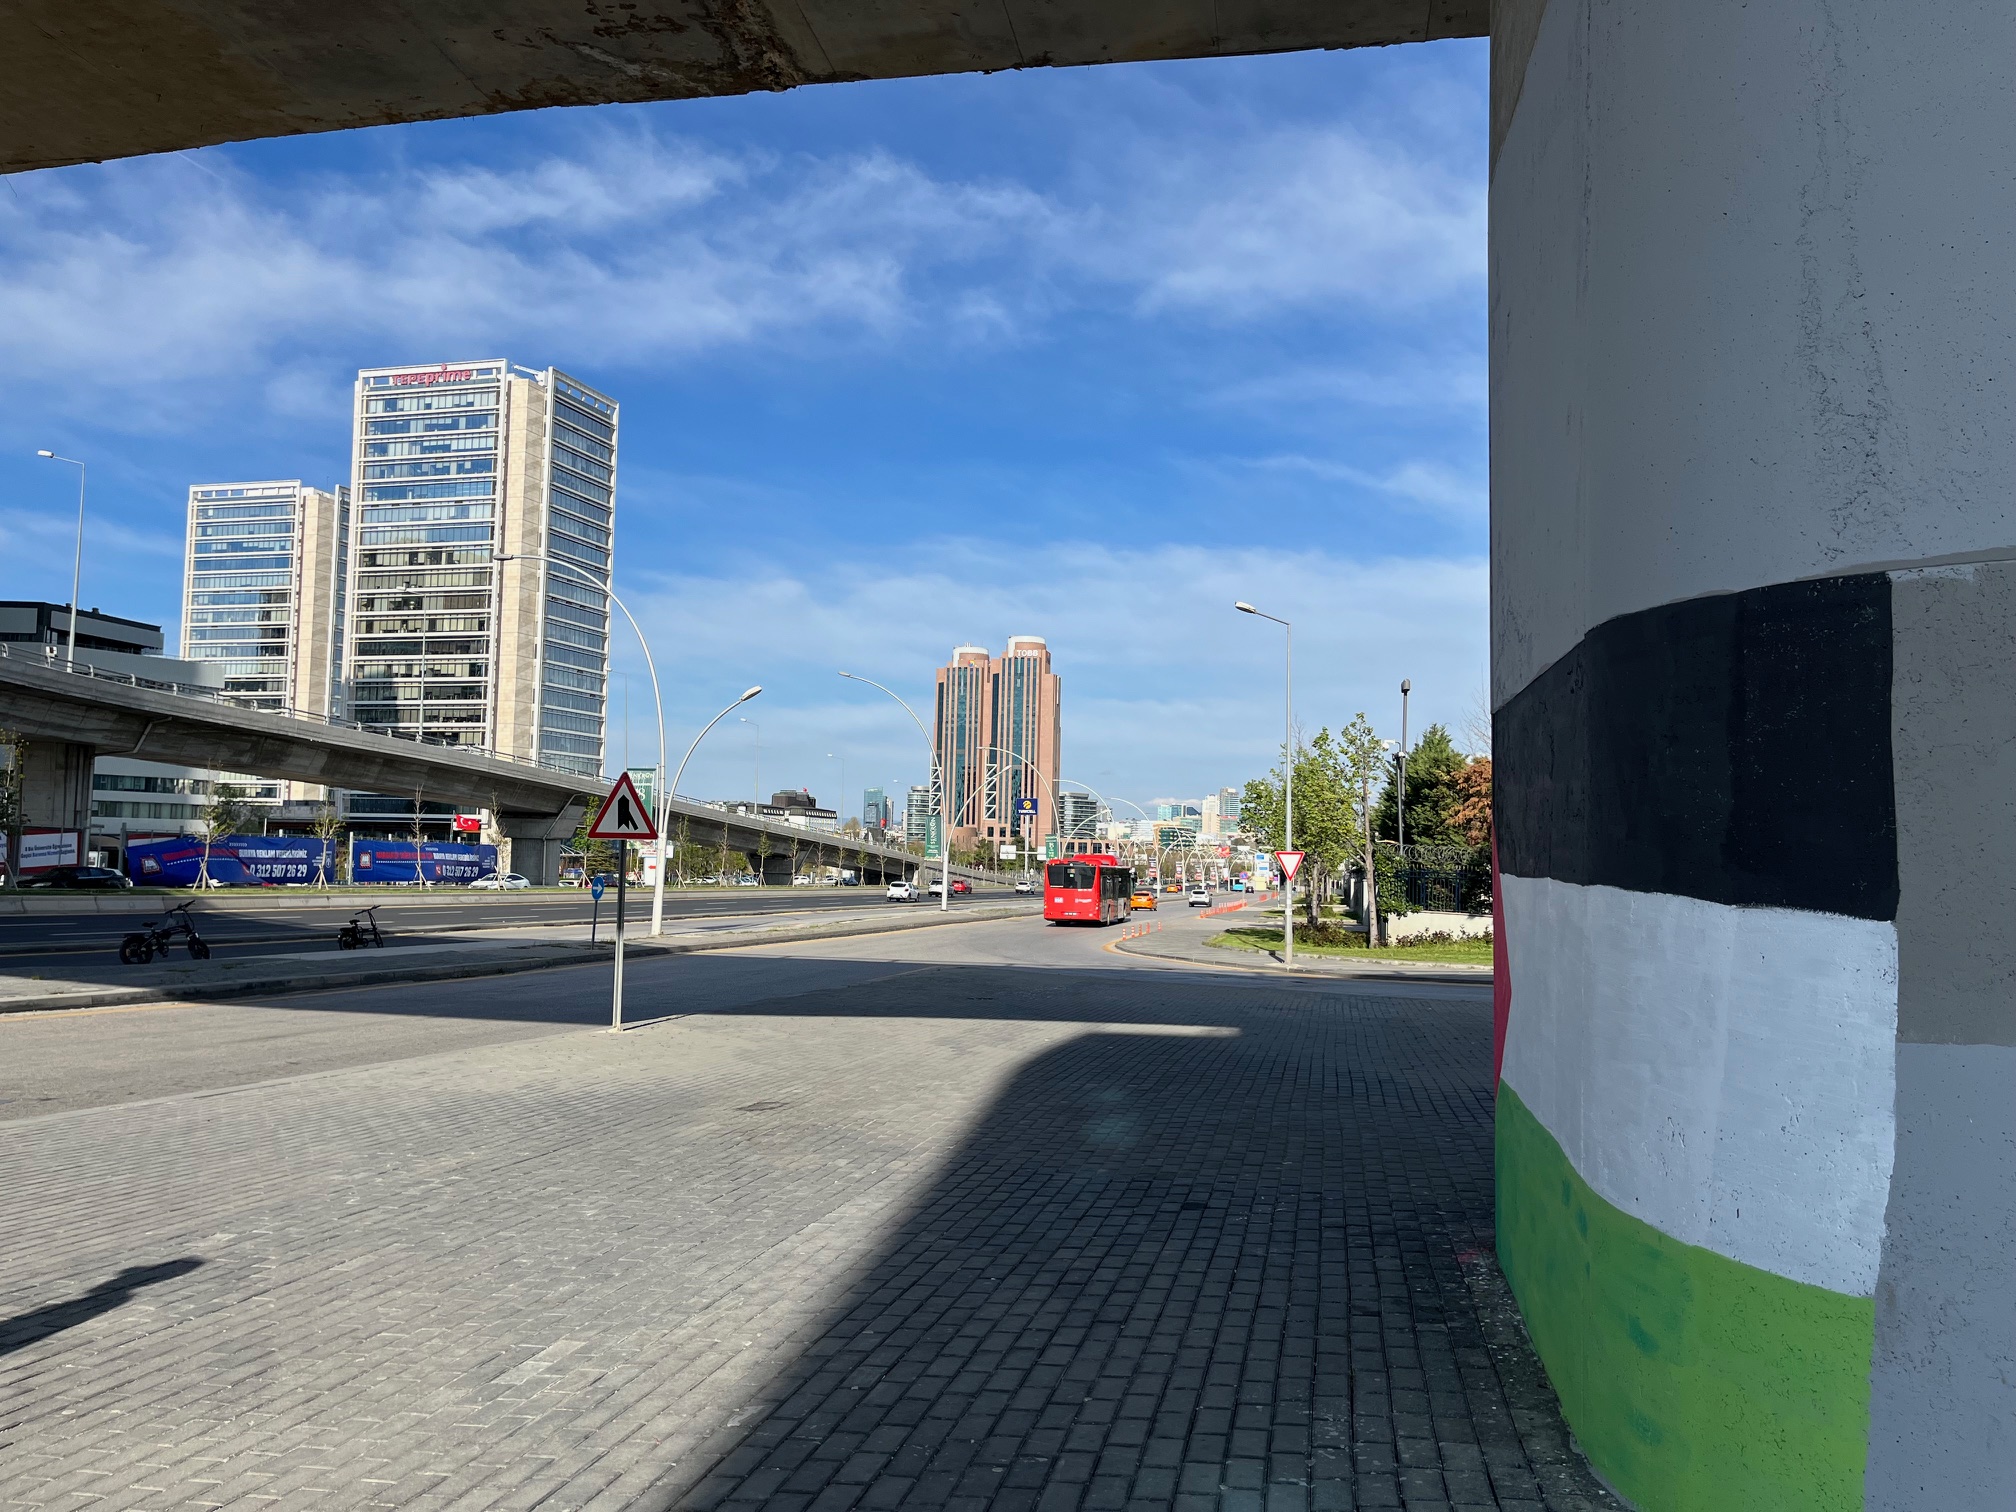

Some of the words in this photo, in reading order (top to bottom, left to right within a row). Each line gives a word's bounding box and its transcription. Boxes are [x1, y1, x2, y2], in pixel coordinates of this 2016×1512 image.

[257, 865, 270, 877] 312
[272, 865, 286, 877] 507
[287, 865, 296, 877] 26
[298, 865, 307, 877] 29
[464, 867, 471, 877] 26
[471, 867, 479, 877] 29
